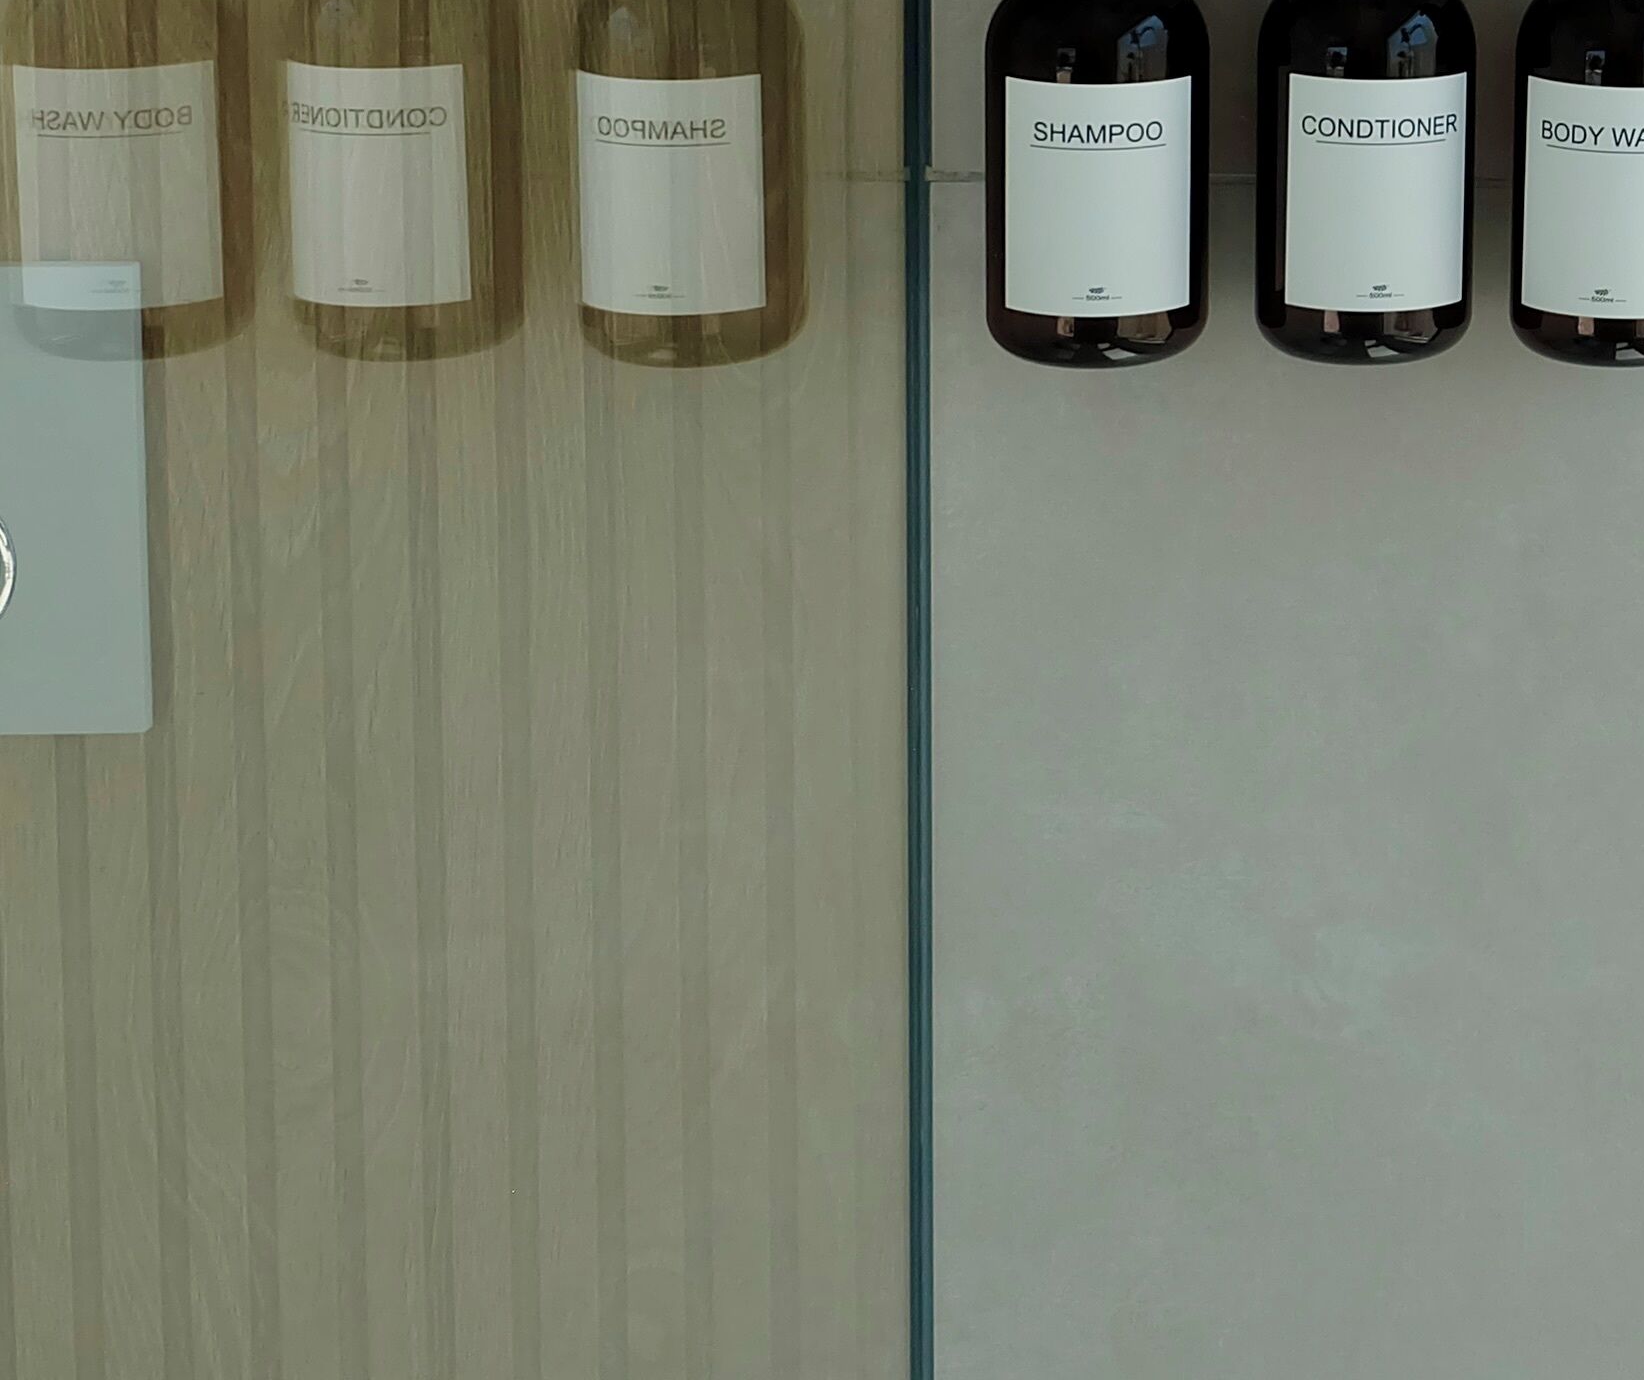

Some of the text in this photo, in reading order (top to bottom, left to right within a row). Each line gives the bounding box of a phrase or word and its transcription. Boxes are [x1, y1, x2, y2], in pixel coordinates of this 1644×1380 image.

[1033, 121, 1163, 144] SHAMPOO
[1301, 113, 1458, 139] CONDTIONER
[1541, 120, 1605, 145] BODY
